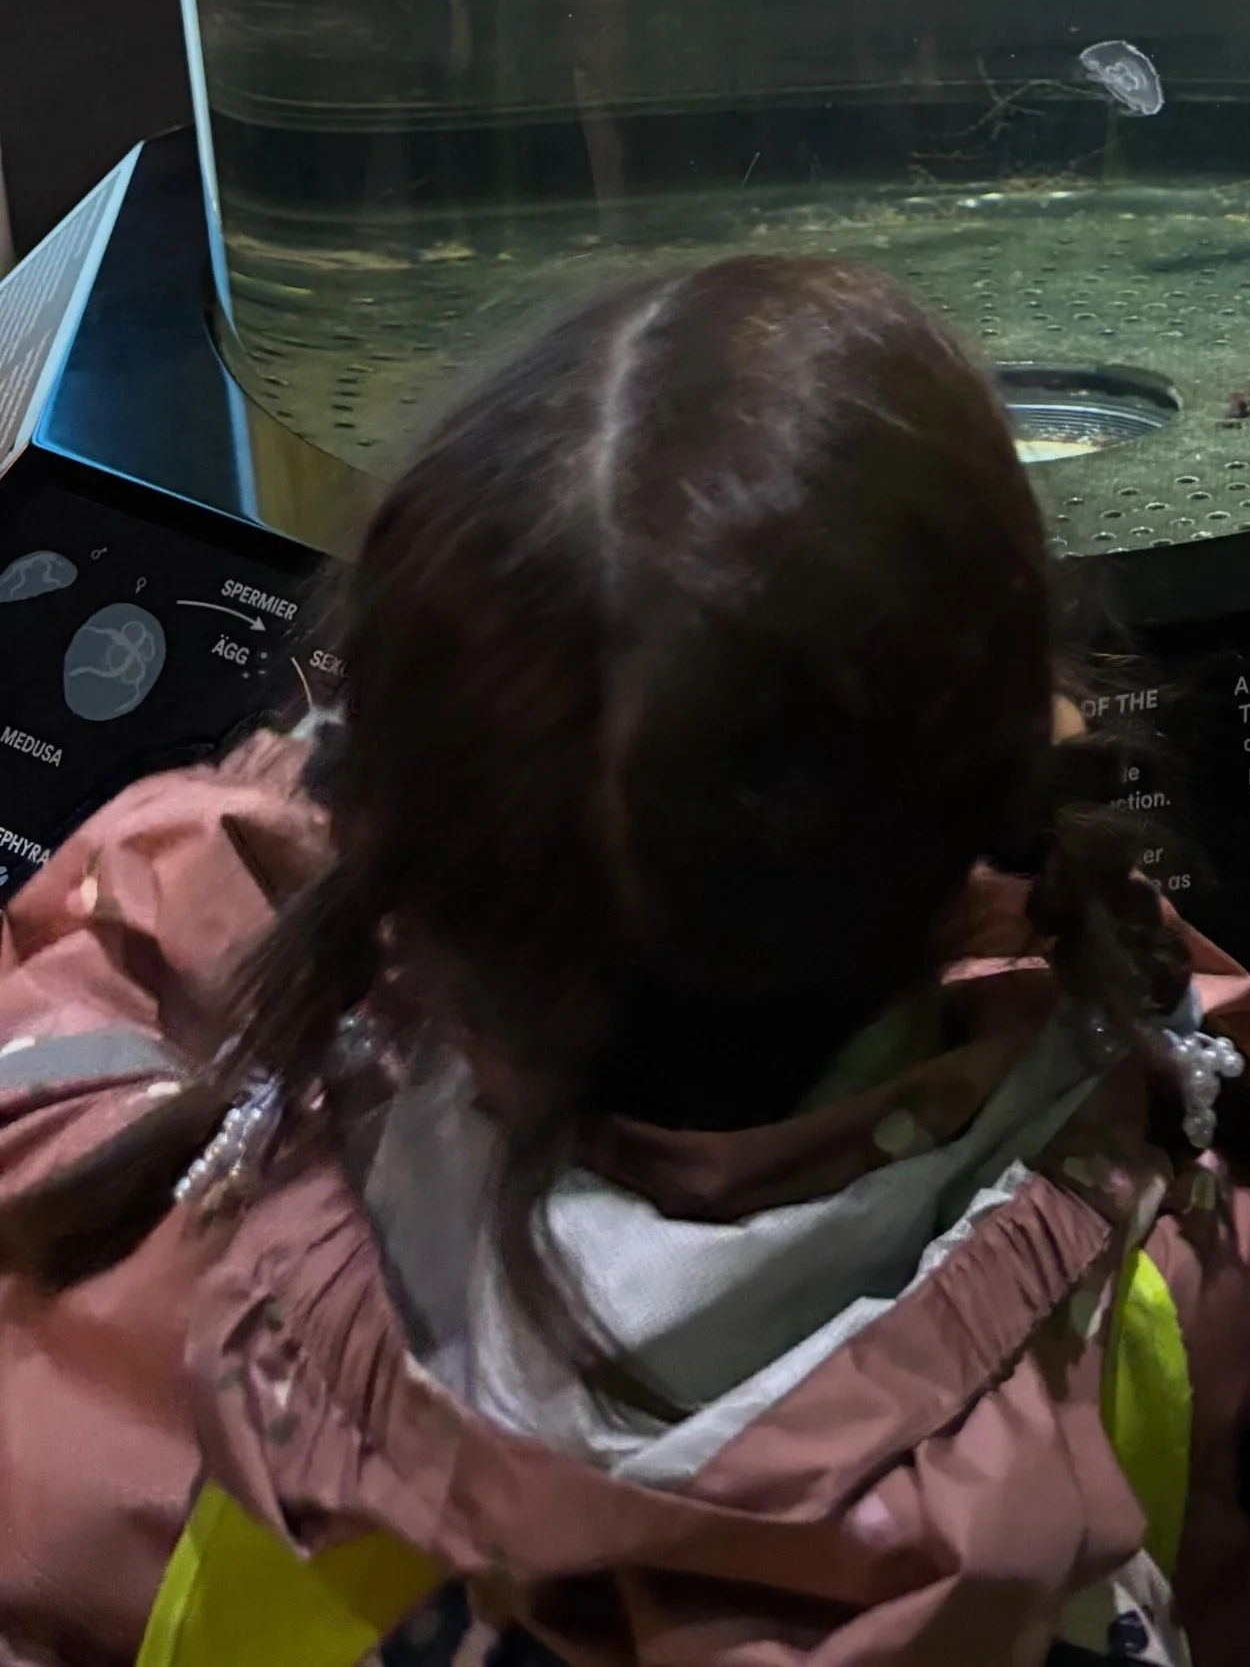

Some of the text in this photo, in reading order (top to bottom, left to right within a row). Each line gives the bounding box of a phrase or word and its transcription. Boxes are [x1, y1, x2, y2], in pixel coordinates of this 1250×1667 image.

[221, 579, 298, 621] SPERMIER
[211, 634, 250, 665] ÄGG
[1234, 675, 1249, 696] A
[1115, 689, 1159, 714] THE
[0, 726, 63, 767] MEDUSA
[1168, 873, 1191, 890] as
